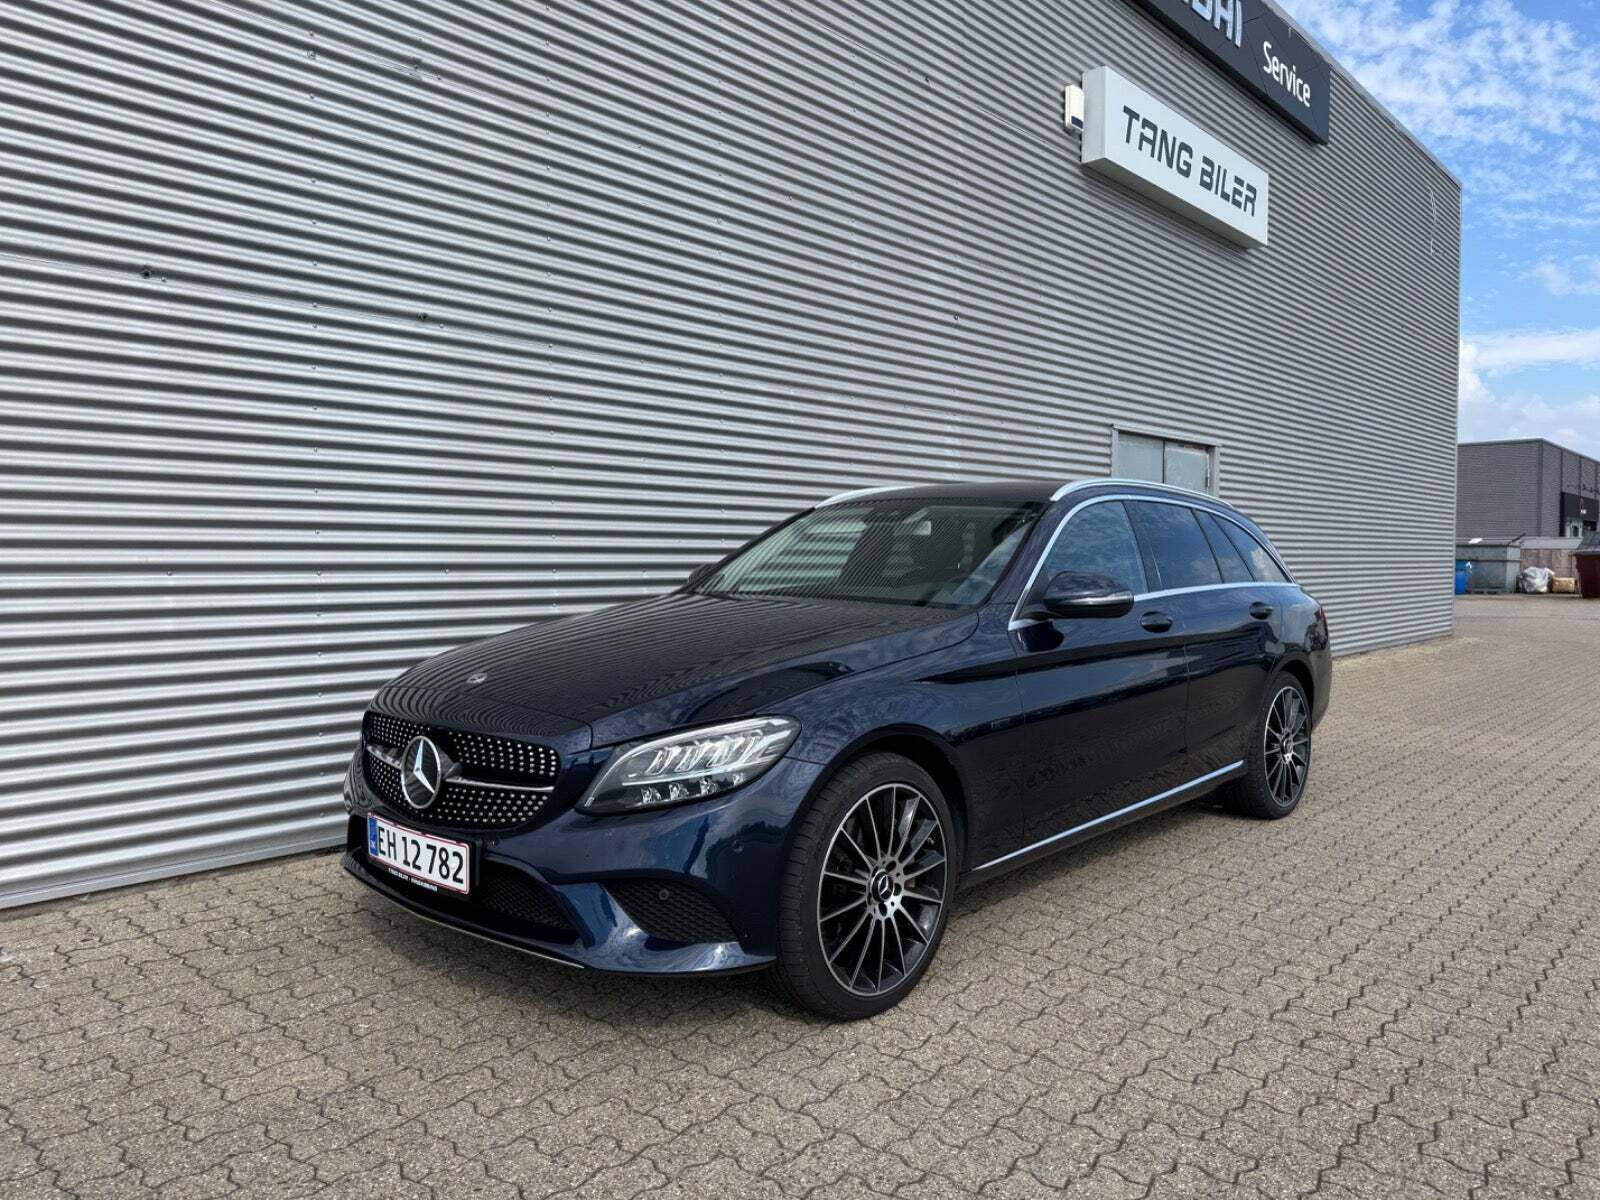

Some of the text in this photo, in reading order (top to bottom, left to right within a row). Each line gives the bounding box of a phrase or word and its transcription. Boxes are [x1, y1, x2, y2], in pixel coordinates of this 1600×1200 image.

[1262, 40, 1311, 107] Service
[1123, 105, 1257, 217] TANG BILER
[378, 826, 397, 861] EH
[401, 836, 422, 871] 12
[426, 843, 464, 884] 782
